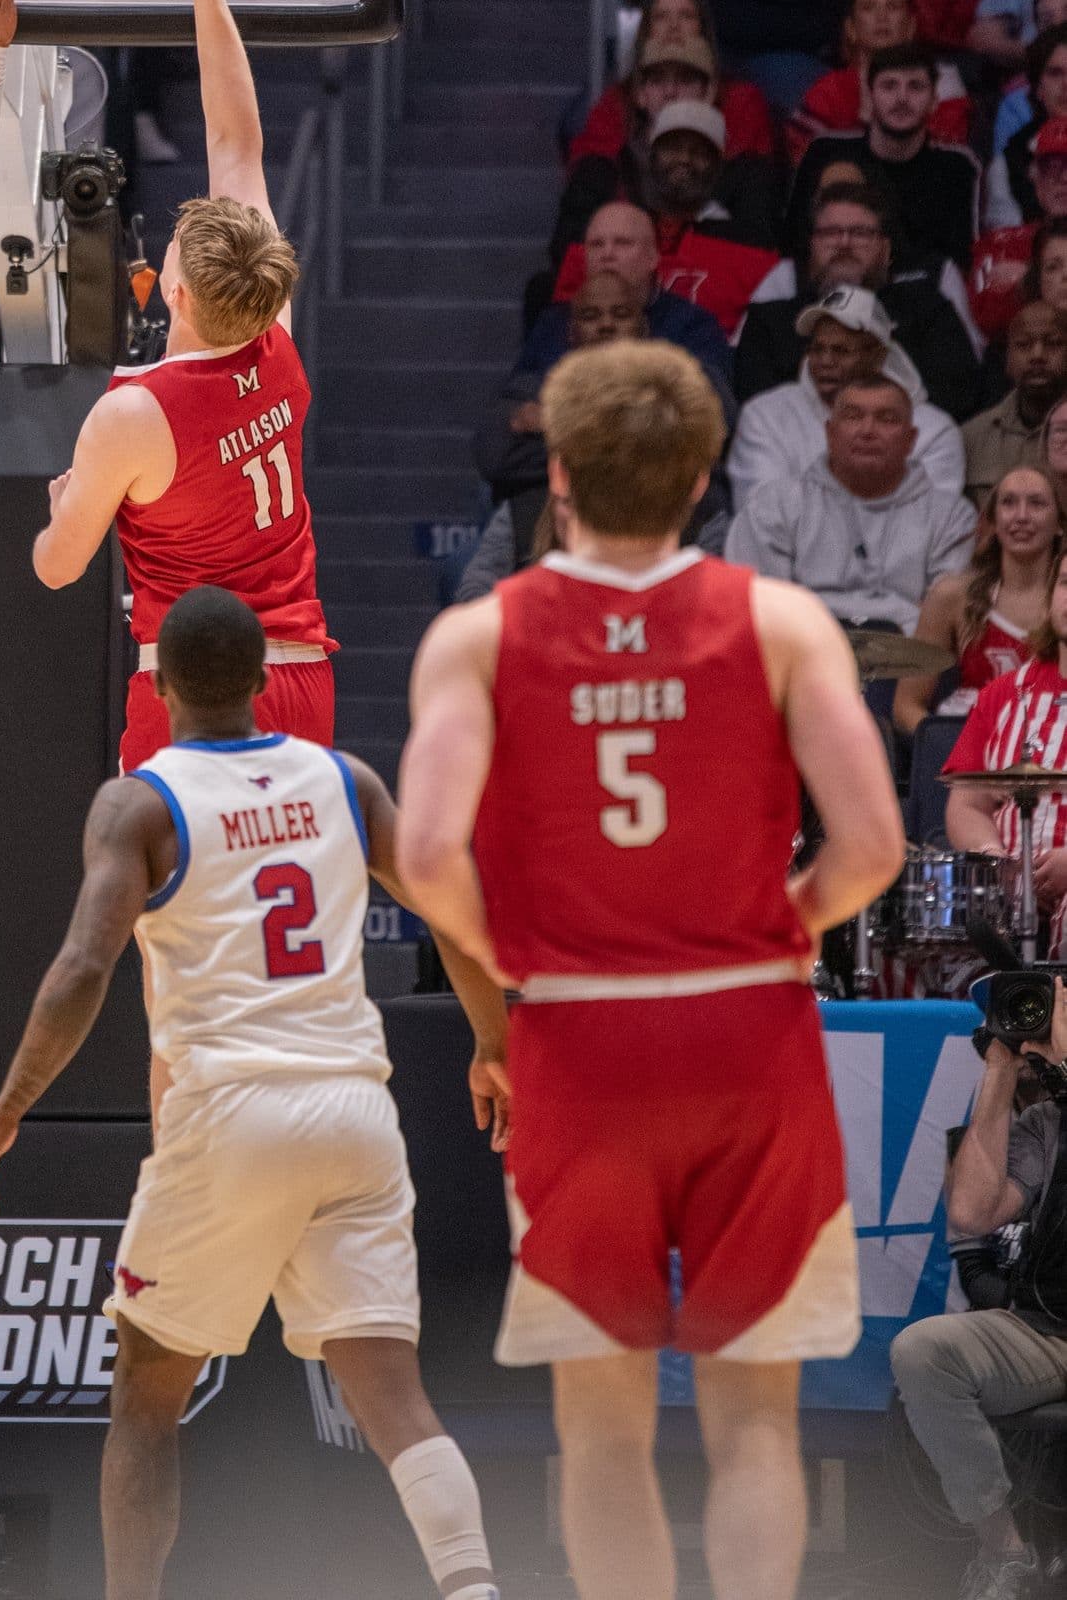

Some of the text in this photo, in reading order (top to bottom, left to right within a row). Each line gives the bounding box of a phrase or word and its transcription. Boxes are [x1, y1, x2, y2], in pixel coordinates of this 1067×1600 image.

[232, 365, 262, 399] M
[218, 398, 293, 466] ATLASON
[241, 440, 295, 532] 11
[603, 613, 648, 654] M
[570, 676, 686, 726] SUDER
[596, 728, 668, 848] 5
[219, 801, 321, 851] MILLER
[252, 861, 326, 981] 2
